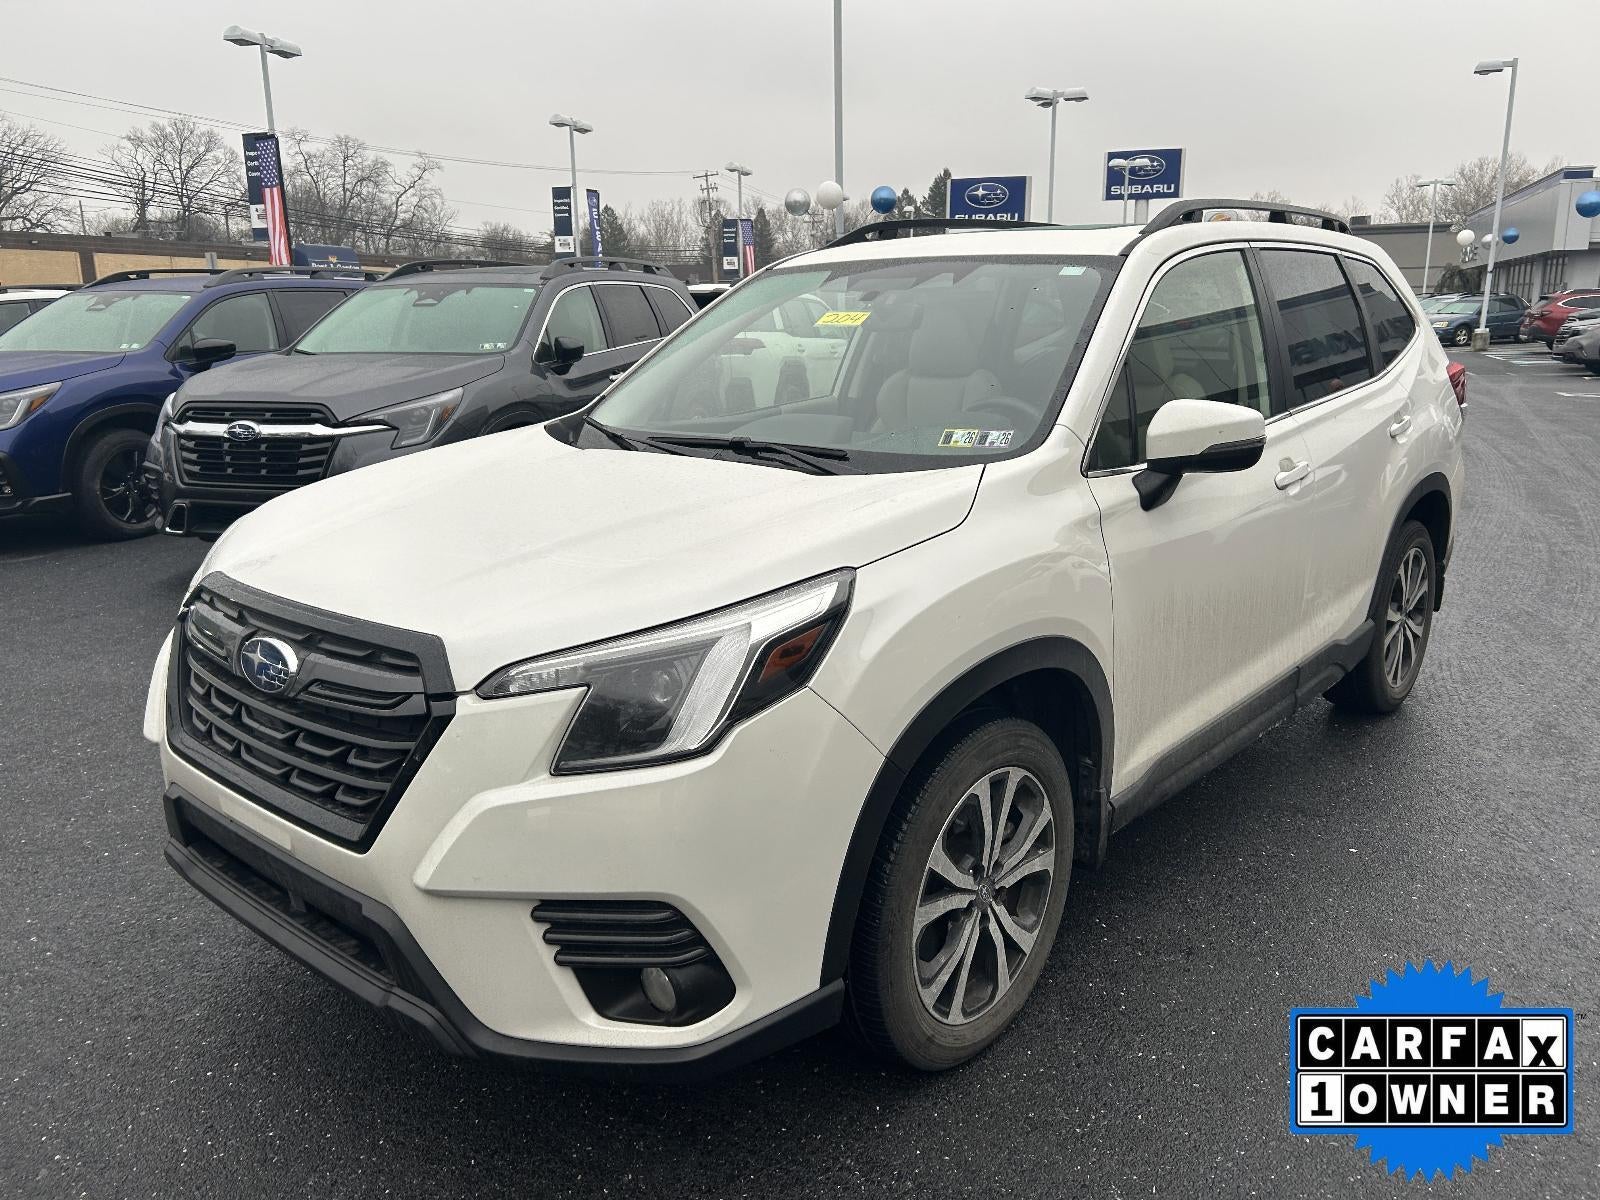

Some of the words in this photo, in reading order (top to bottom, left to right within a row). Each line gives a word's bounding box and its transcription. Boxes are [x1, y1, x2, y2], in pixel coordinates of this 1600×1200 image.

[1110, 183, 1175, 195] SUBARU
[822, 313, 867, 324] 204
[963, 431, 976, 444] 26
[1000, 432, 1012, 445] 26
